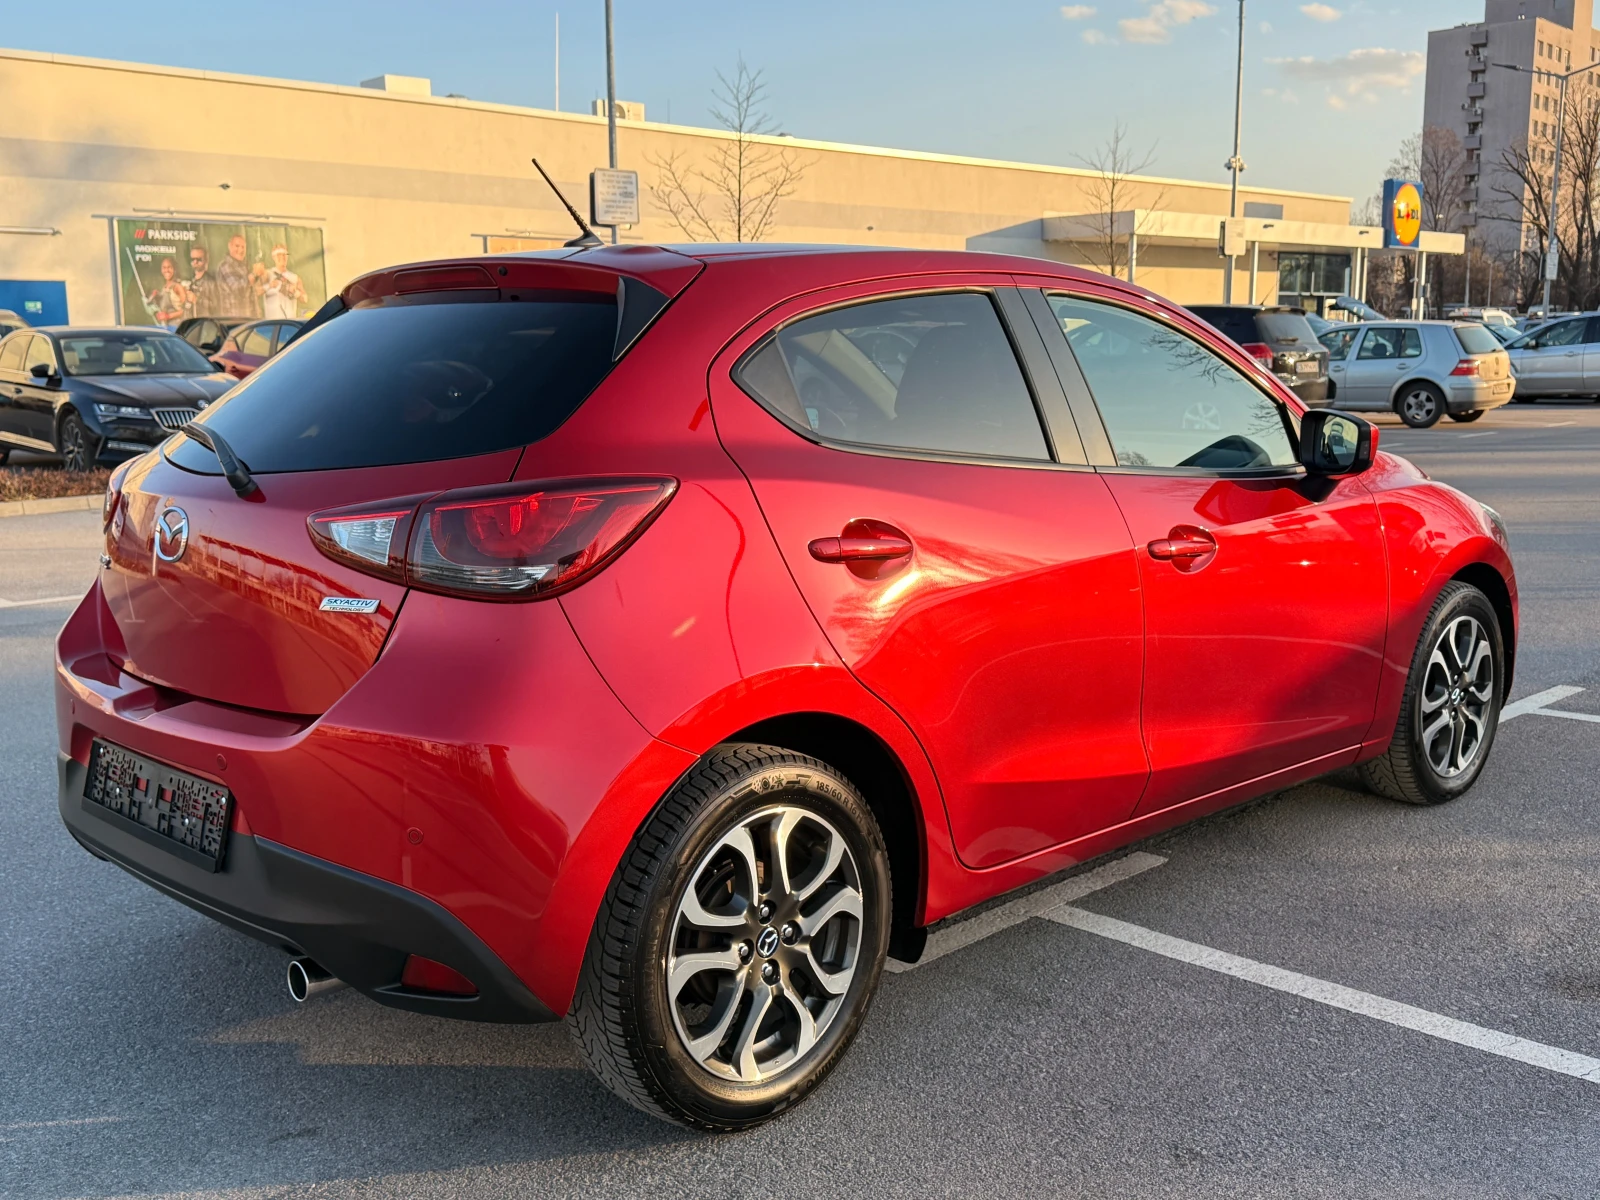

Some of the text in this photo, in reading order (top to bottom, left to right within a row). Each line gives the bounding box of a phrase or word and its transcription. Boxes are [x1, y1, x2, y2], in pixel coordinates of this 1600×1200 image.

[148, 229, 196, 240] PARKSIDE
[327, 598, 373, 607] SKYACTIV
[816, 780, 842, 801] 185/60
[842, 797, 849, 808] R
[850, 802, 857, 815] 16
